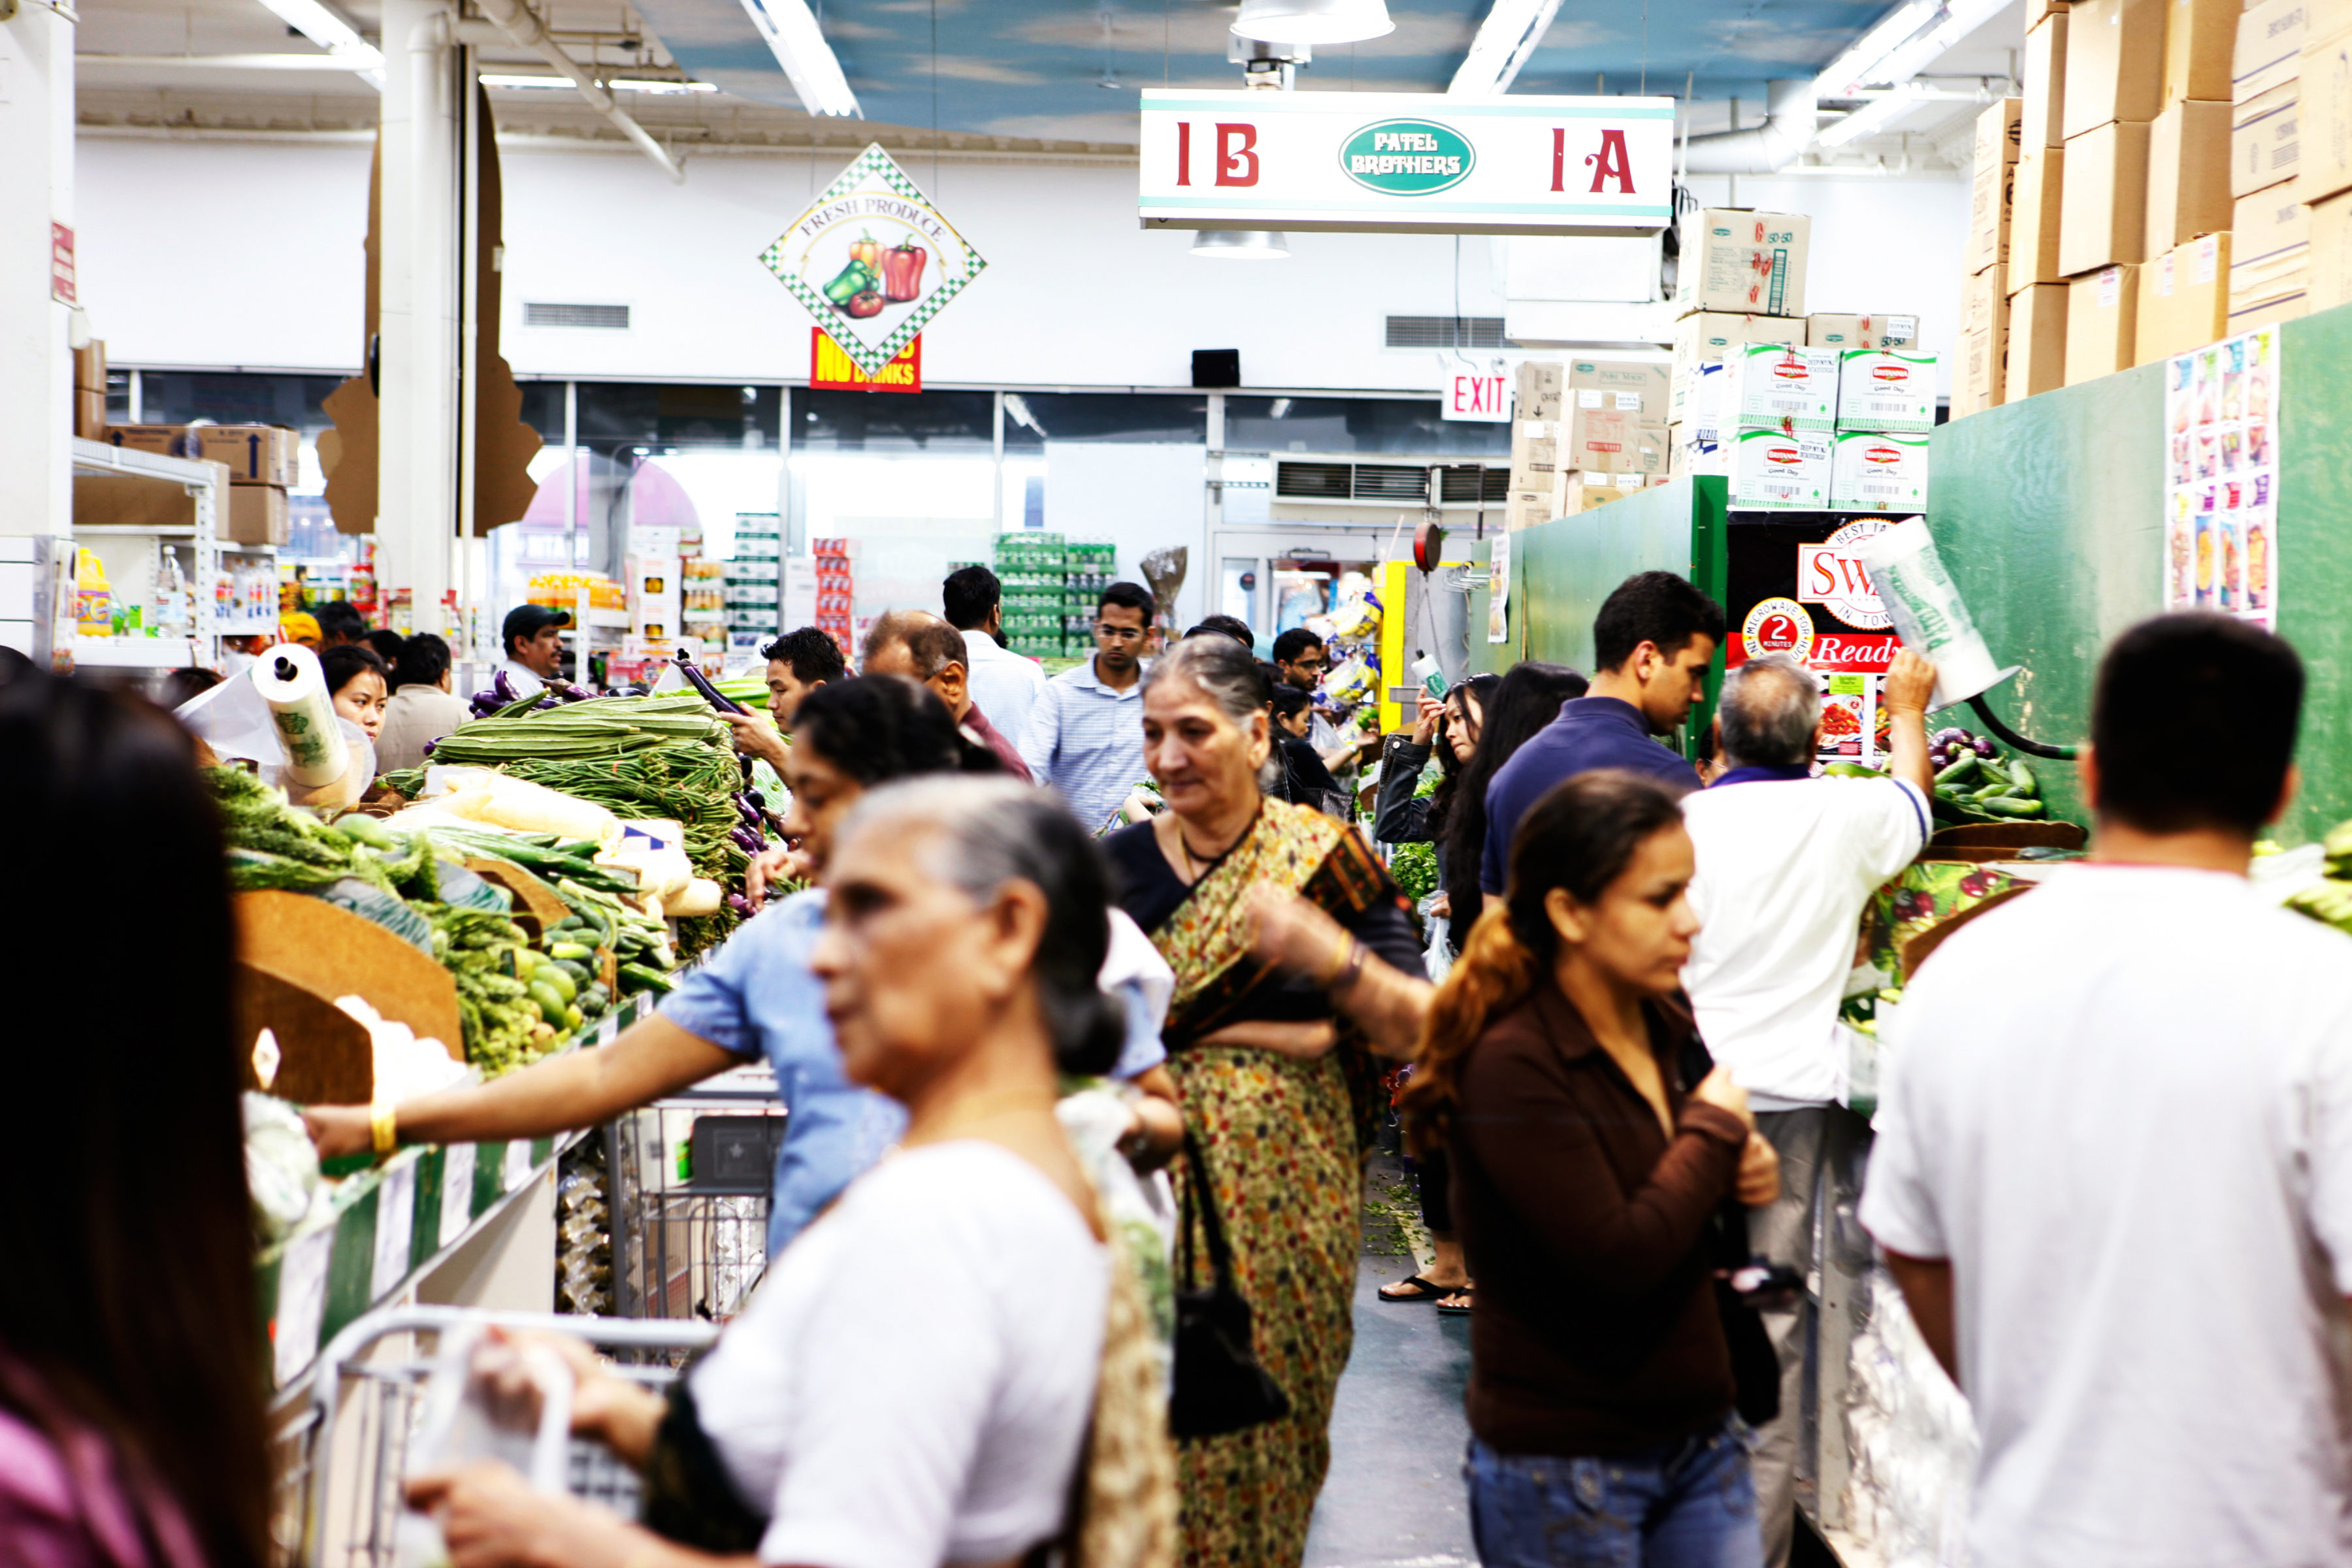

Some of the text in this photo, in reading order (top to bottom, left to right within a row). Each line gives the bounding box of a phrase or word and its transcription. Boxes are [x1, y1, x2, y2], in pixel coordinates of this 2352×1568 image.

[1374, 133, 1439, 152] PATEL
[1350, 155, 1462, 176] BROTHERS
[800, 199, 946, 241] FRESH PRODUCE
[1775, 367, 1806, 375] BRITANNI
[1455, 376, 1505, 413] EXIT
[1836, 524, 1864, 544] BEST
[1746, 602, 1810, 635] MICROWAVE FOR
[1838, 606, 1894, 626] IN TOW
[1771, 615, 1788, 640] 2
[1747, 640, 1758, 653] IN
